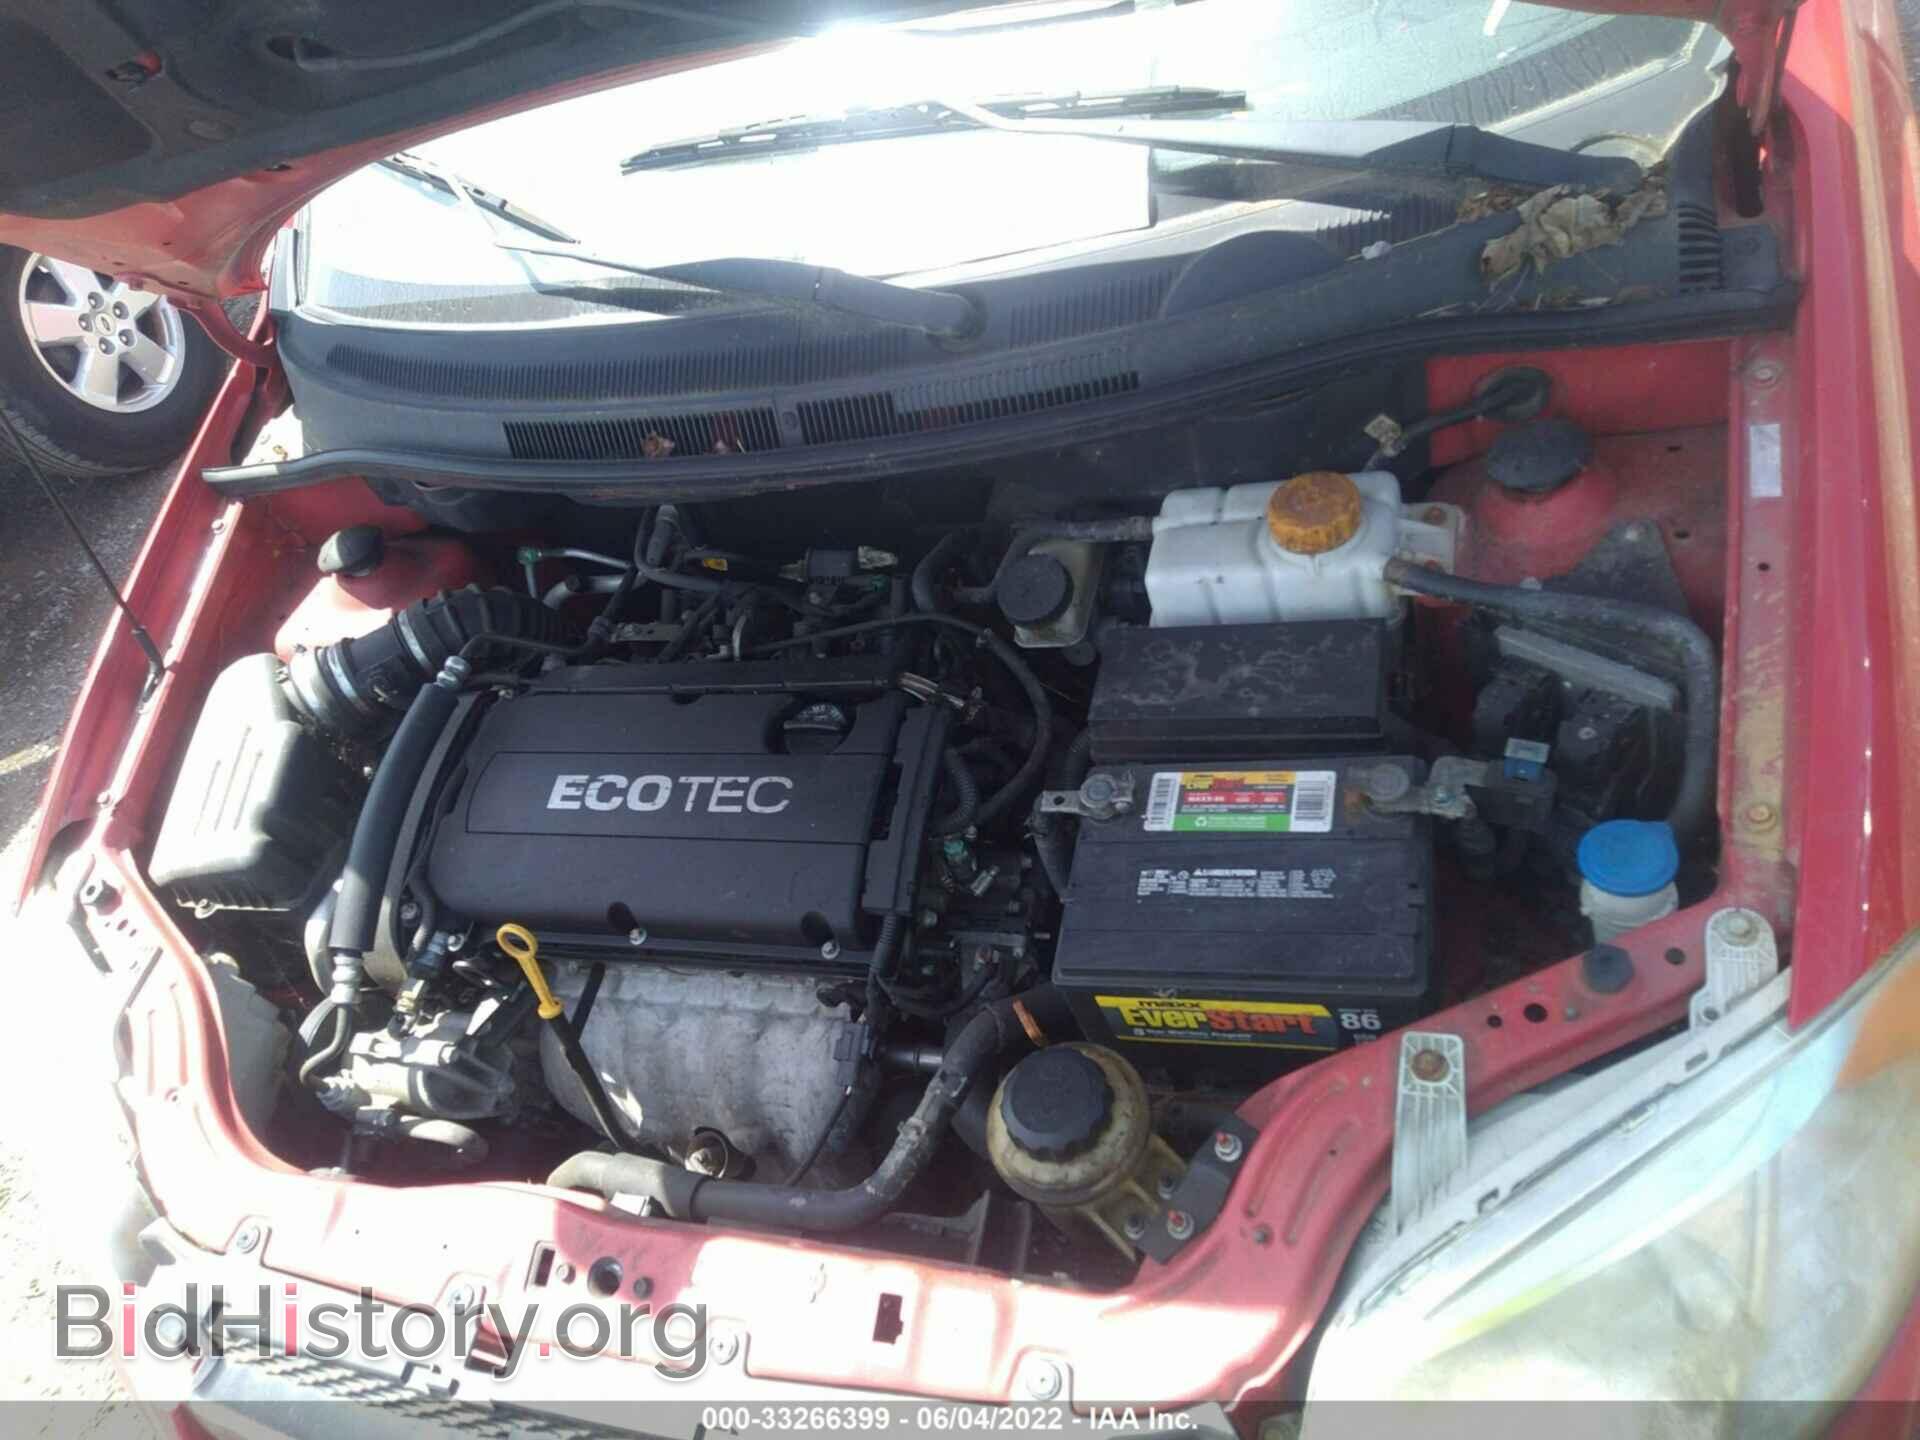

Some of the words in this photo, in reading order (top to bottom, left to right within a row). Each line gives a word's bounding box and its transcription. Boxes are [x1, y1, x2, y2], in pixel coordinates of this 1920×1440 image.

[546, 774, 793, 813] ECOTEC
[1120, 1005, 1318, 1035] EverStart
[1340, 1012, 1382, 1031] 86
